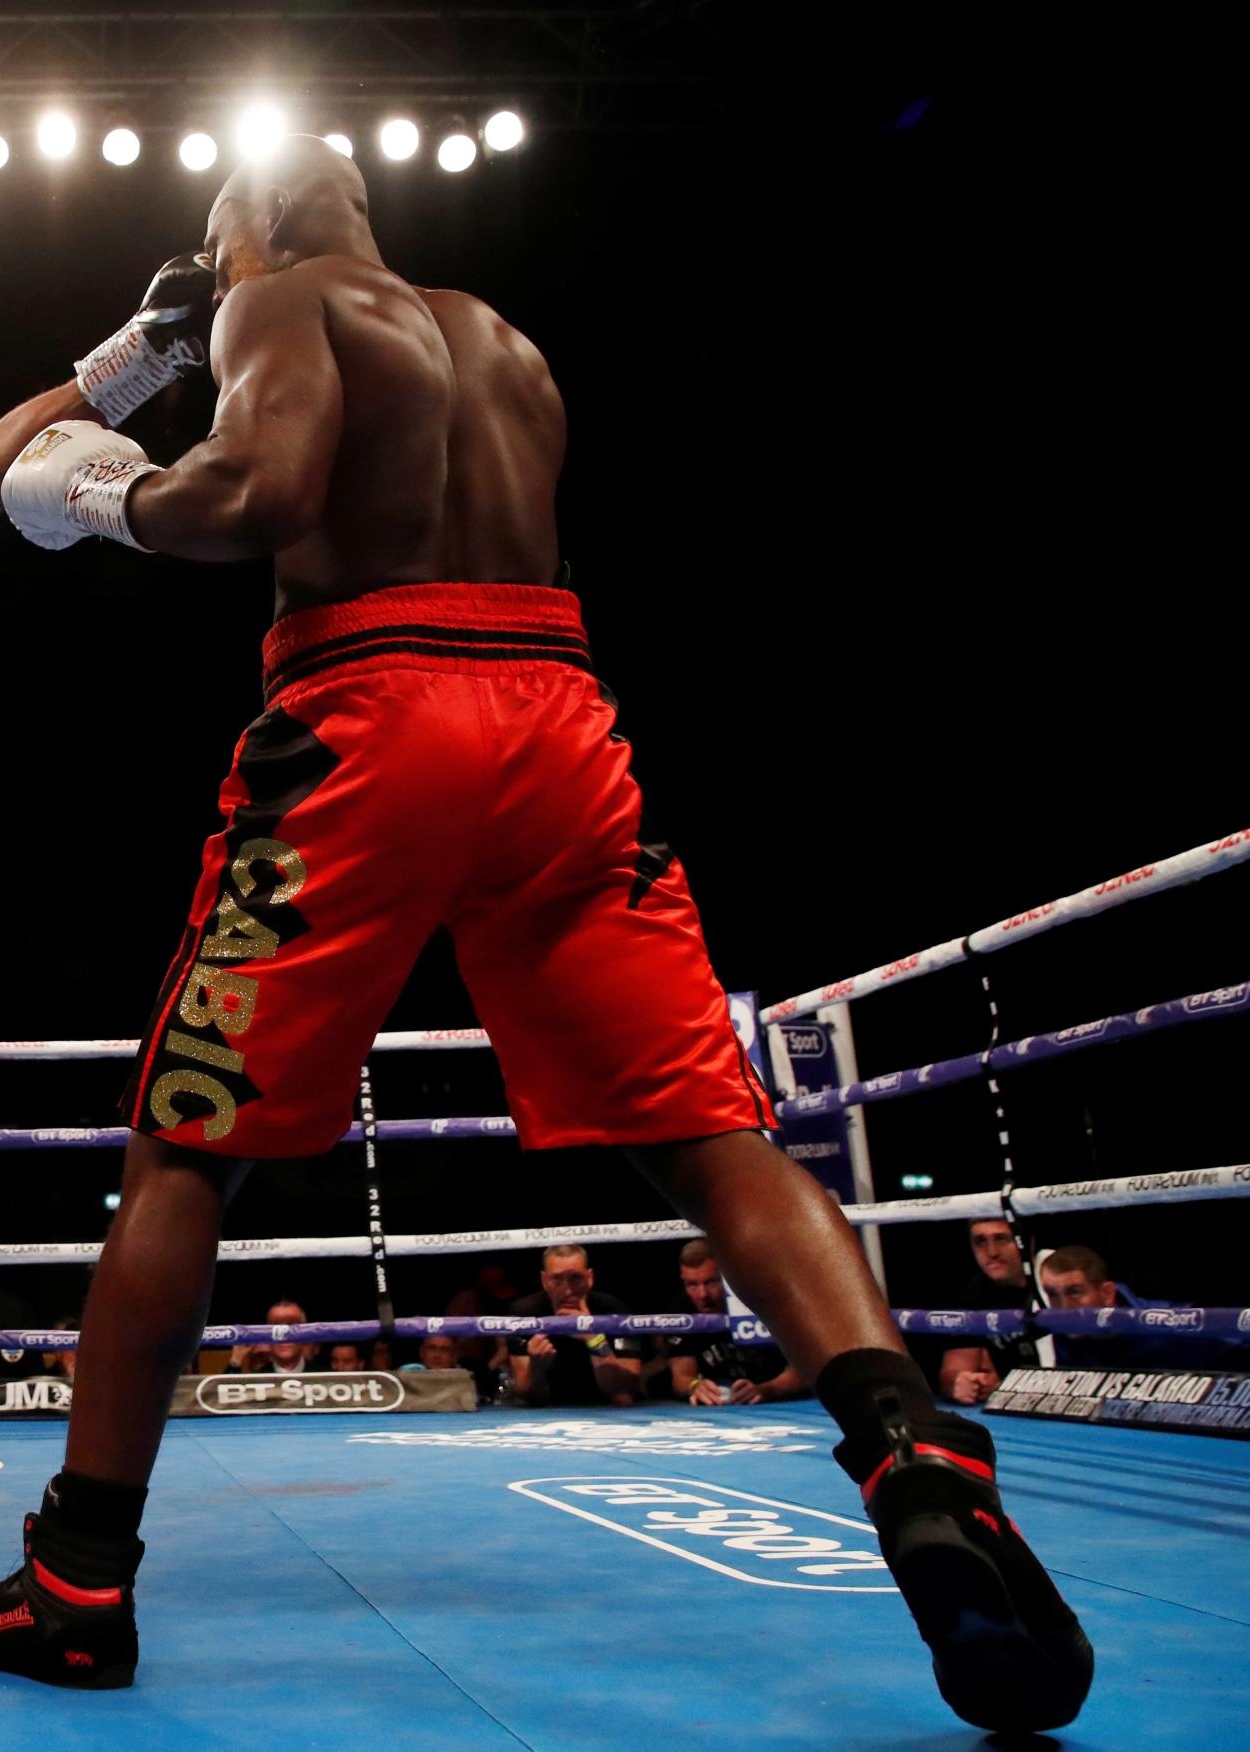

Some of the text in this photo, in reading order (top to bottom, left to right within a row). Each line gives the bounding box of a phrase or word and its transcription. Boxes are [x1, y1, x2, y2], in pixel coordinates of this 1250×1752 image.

[150, 837, 308, 1142] CABIC
[217, 1379, 384, 1406] BT Sport
[1099, 1371, 1131, 1400] VS
[562, 1483, 726, 1508] BT
